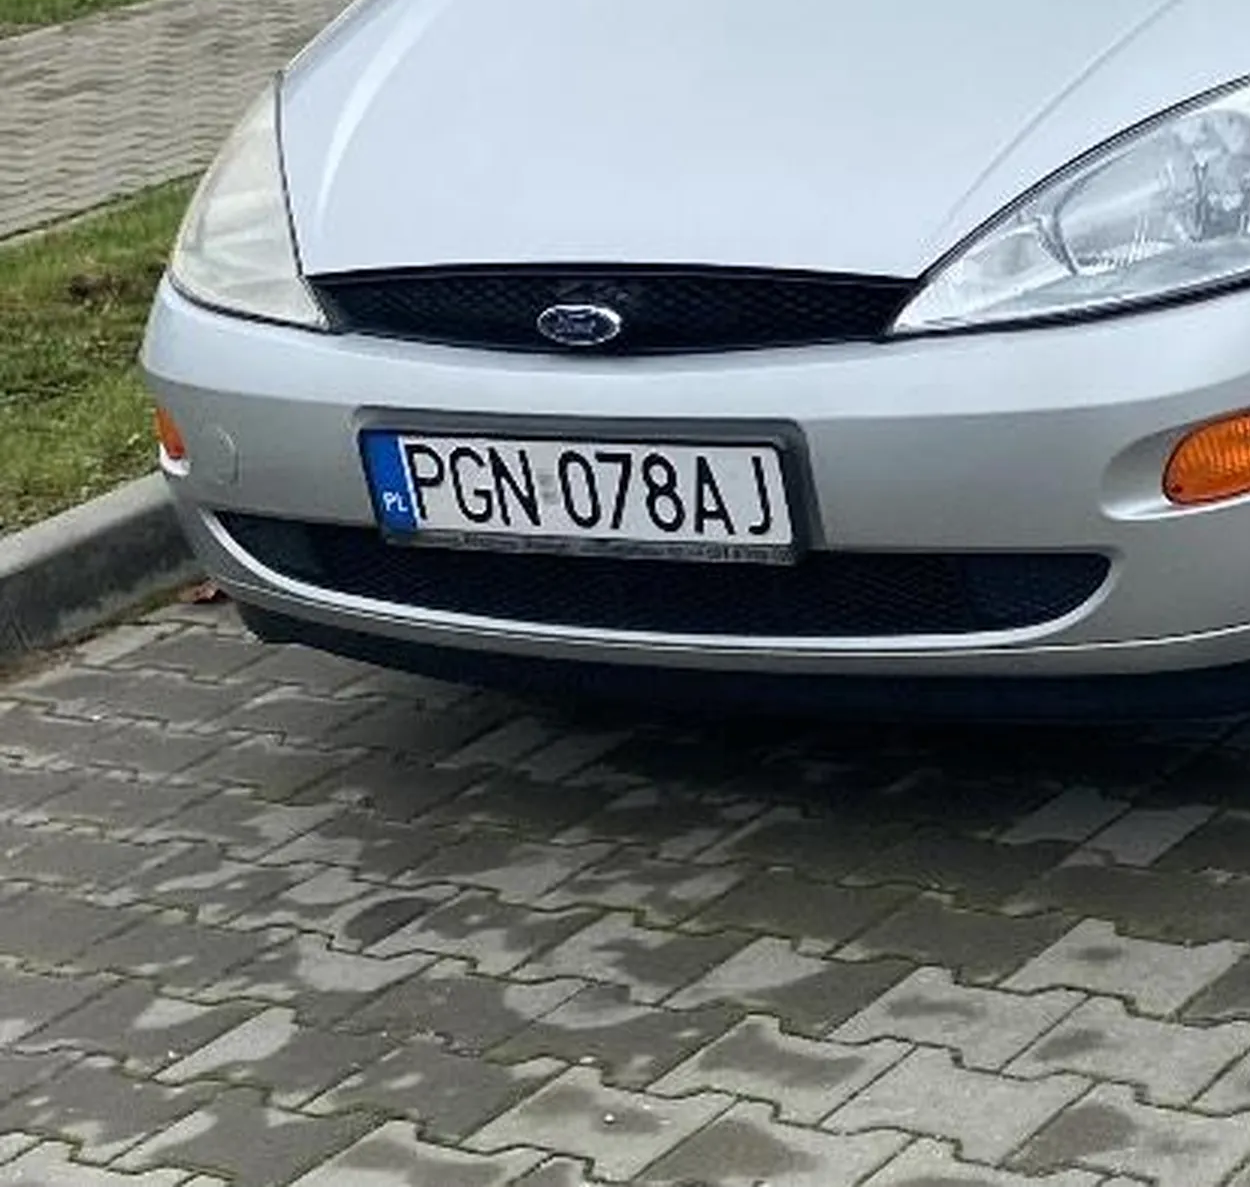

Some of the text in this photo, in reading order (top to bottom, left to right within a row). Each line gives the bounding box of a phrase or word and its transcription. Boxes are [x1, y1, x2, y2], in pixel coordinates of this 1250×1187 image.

[382, 491, 408, 513] PL
[404, 443, 772, 537] PGN 078AJ
